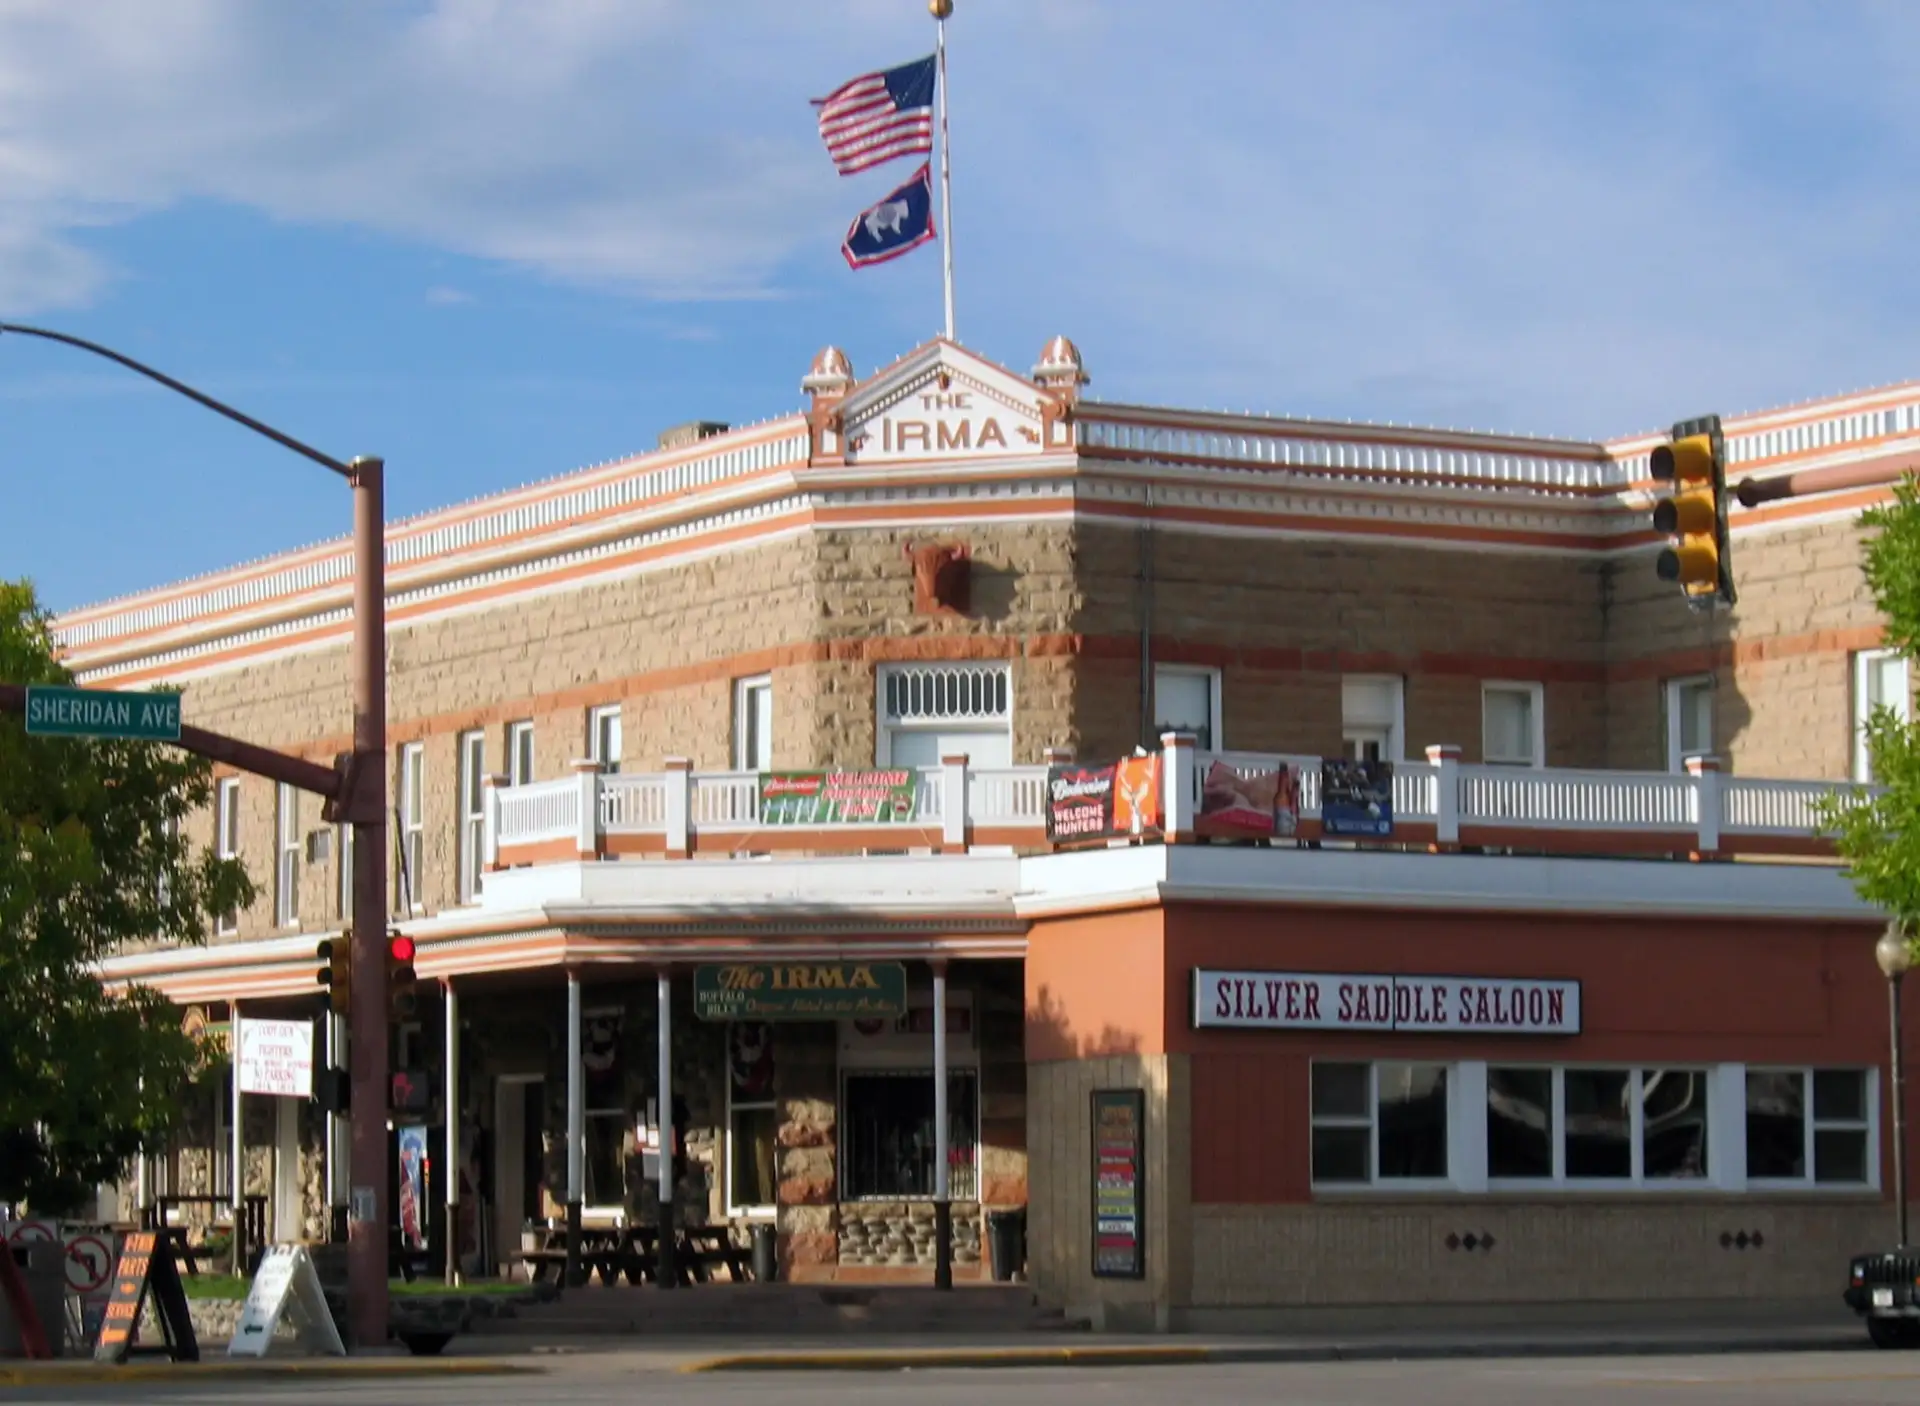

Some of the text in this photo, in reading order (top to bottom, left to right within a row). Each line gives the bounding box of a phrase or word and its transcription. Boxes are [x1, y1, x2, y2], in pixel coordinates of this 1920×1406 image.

[918, 391, 973, 411] THE
[882, 417, 1007, 452] IRMA
[30, 697, 177, 729] SHERIDAN AVE
[826, 771, 908, 786] WELCOME
[1051, 777, 1110, 800] Budweiser
[1054, 804, 1104, 821] WELCOME
[1054, 818, 1104, 836] HUNTERS
[717, 965, 881, 990] The IRMA
[699, 991, 745, 1003] BUFFALO
[1216, 978, 1565, 1026] SILVER SADDLE SALOON
[117, 1256, 149, 1277] PARTS
